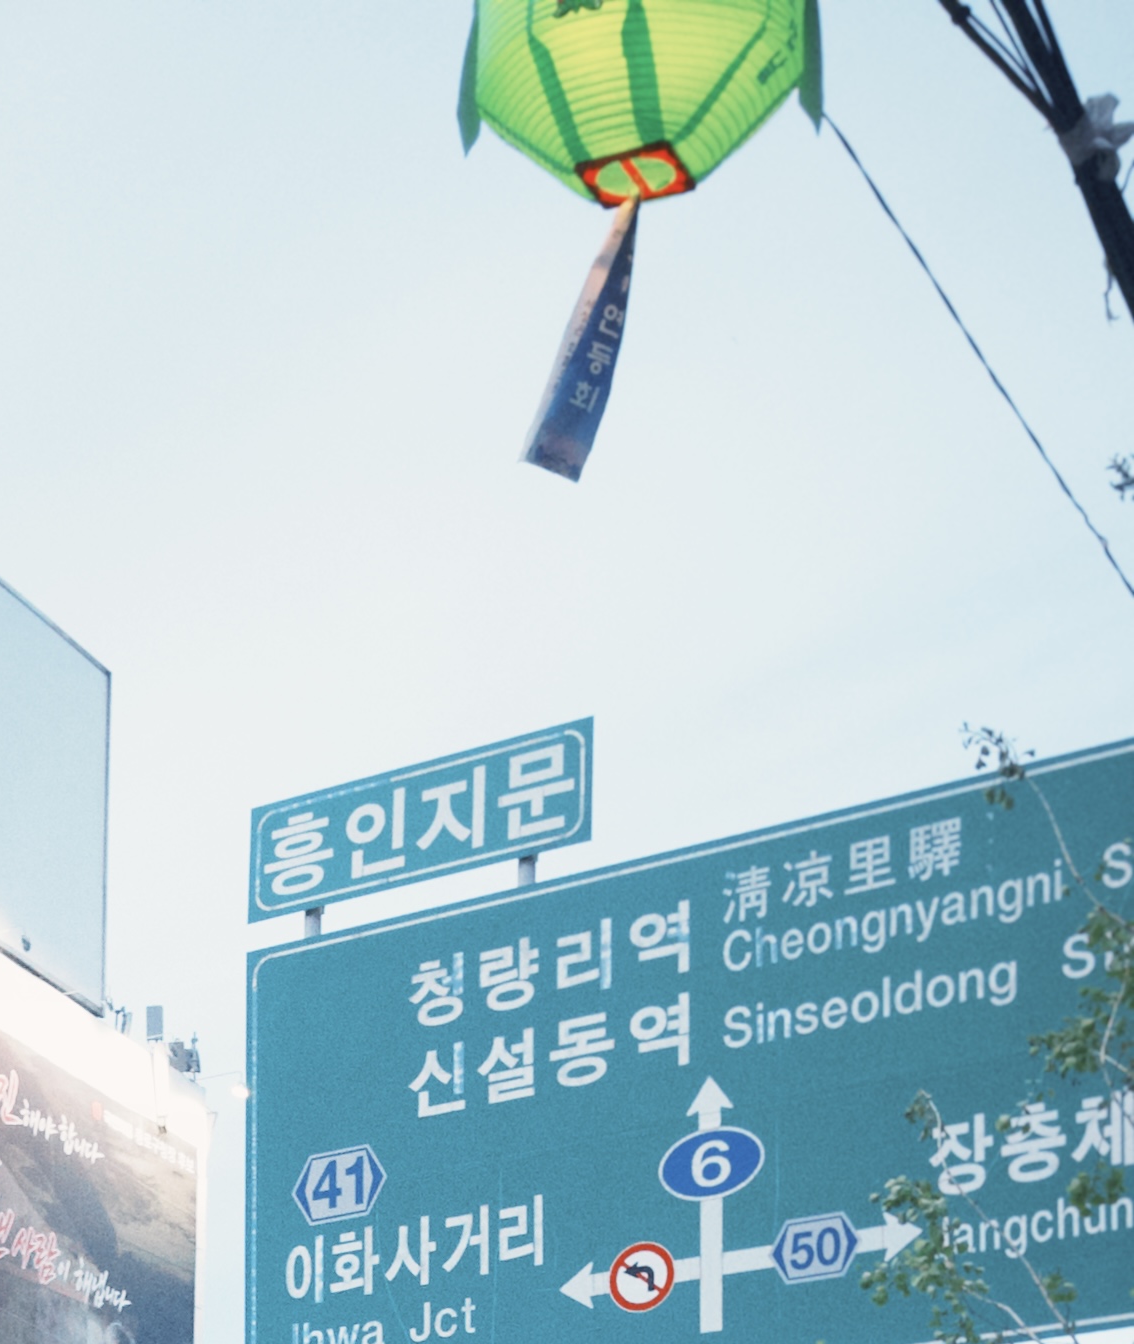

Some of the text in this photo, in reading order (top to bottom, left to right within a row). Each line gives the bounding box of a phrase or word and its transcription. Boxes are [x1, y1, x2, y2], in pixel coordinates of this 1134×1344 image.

[264, 743, 575, 896] 흥인지문
[409, 899, 690, 1030] 청량리역
[723, 858, 1064, 974] Cheongnyangni
[723, 959, 1018, 1050] Sinseoldong
[408, 992, 691, 1119] 신설동역
[312, 1155, 366, 1209] 41
[691, 1139, 732, 1188] 6
[286, 1193, 544, 1303] 이화사거리
[790, 1225, 842, 1271] 50
[409, 1296, 477, 1343] Jct
